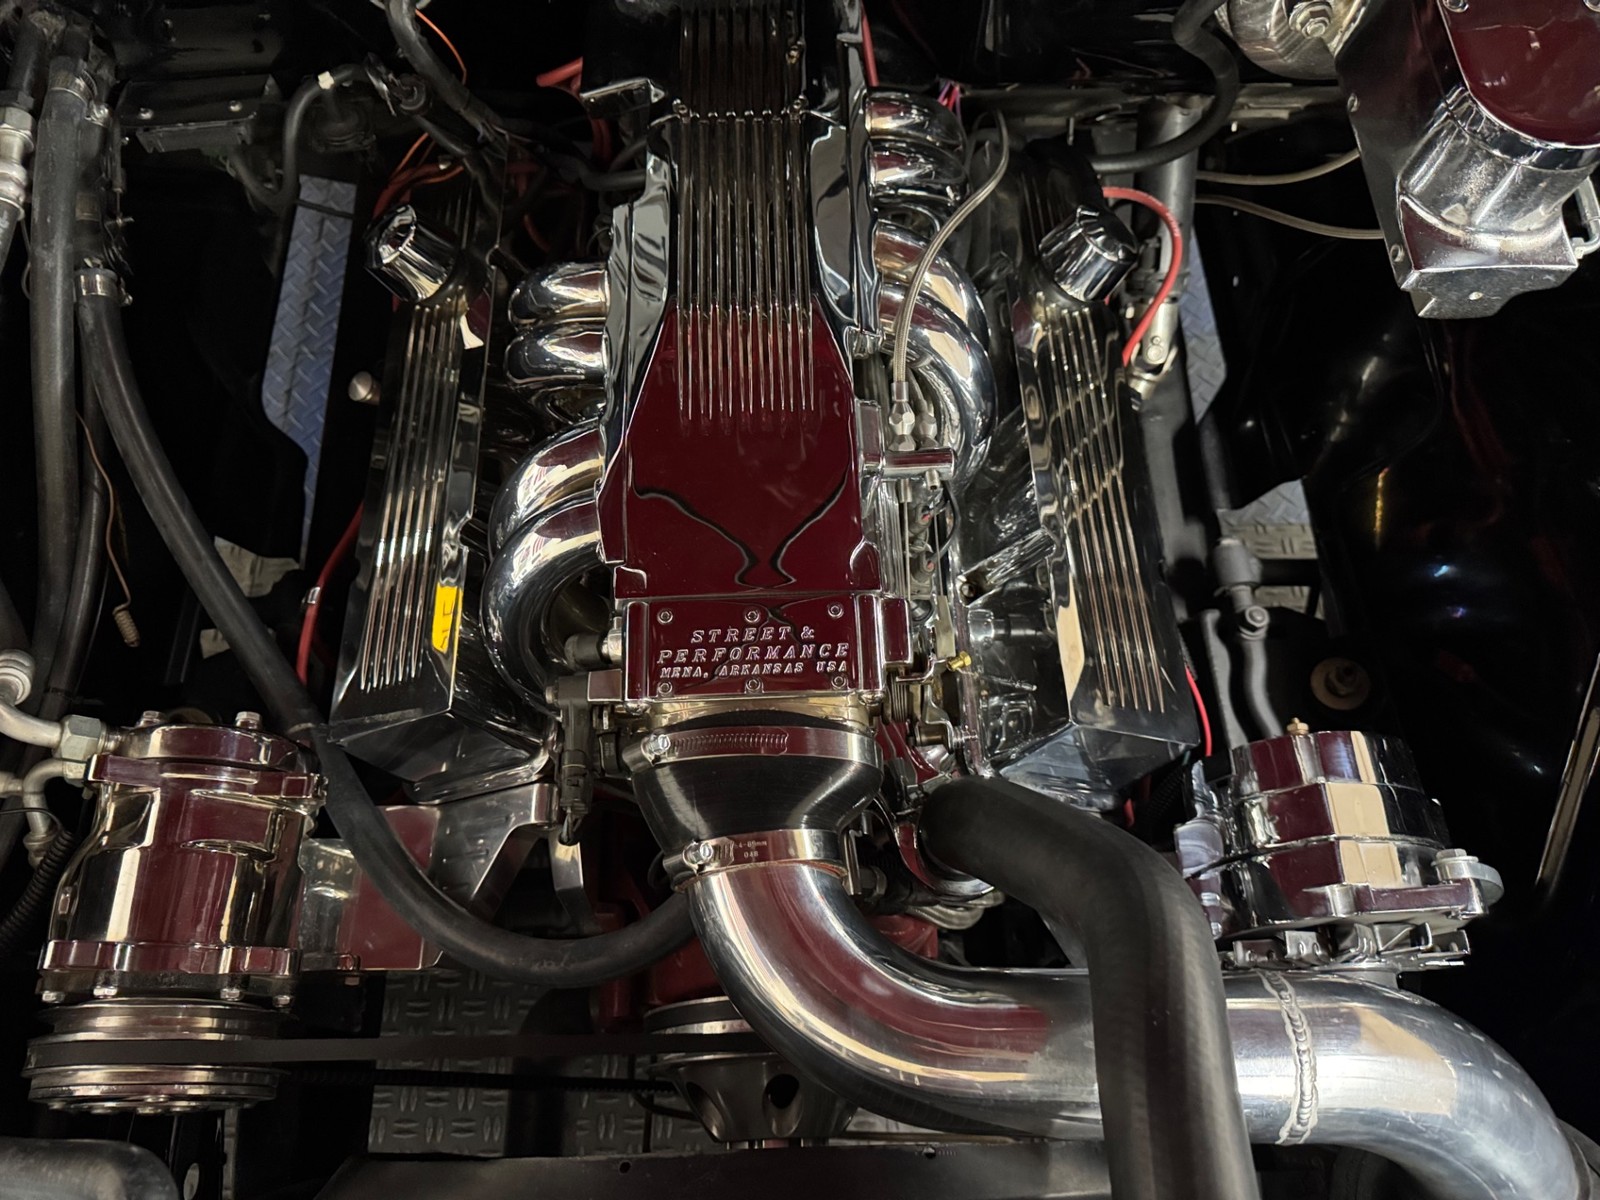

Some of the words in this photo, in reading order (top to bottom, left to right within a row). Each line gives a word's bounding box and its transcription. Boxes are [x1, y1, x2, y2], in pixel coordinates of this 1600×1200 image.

[690, 626, 791, 644] STREET
[801, 625, 815, 640] &
[656, 642, 850, 664] PERFORMANCE
[718, 662, 804, 677] ARKANSAS
[816, 660, 847, 673] USA
